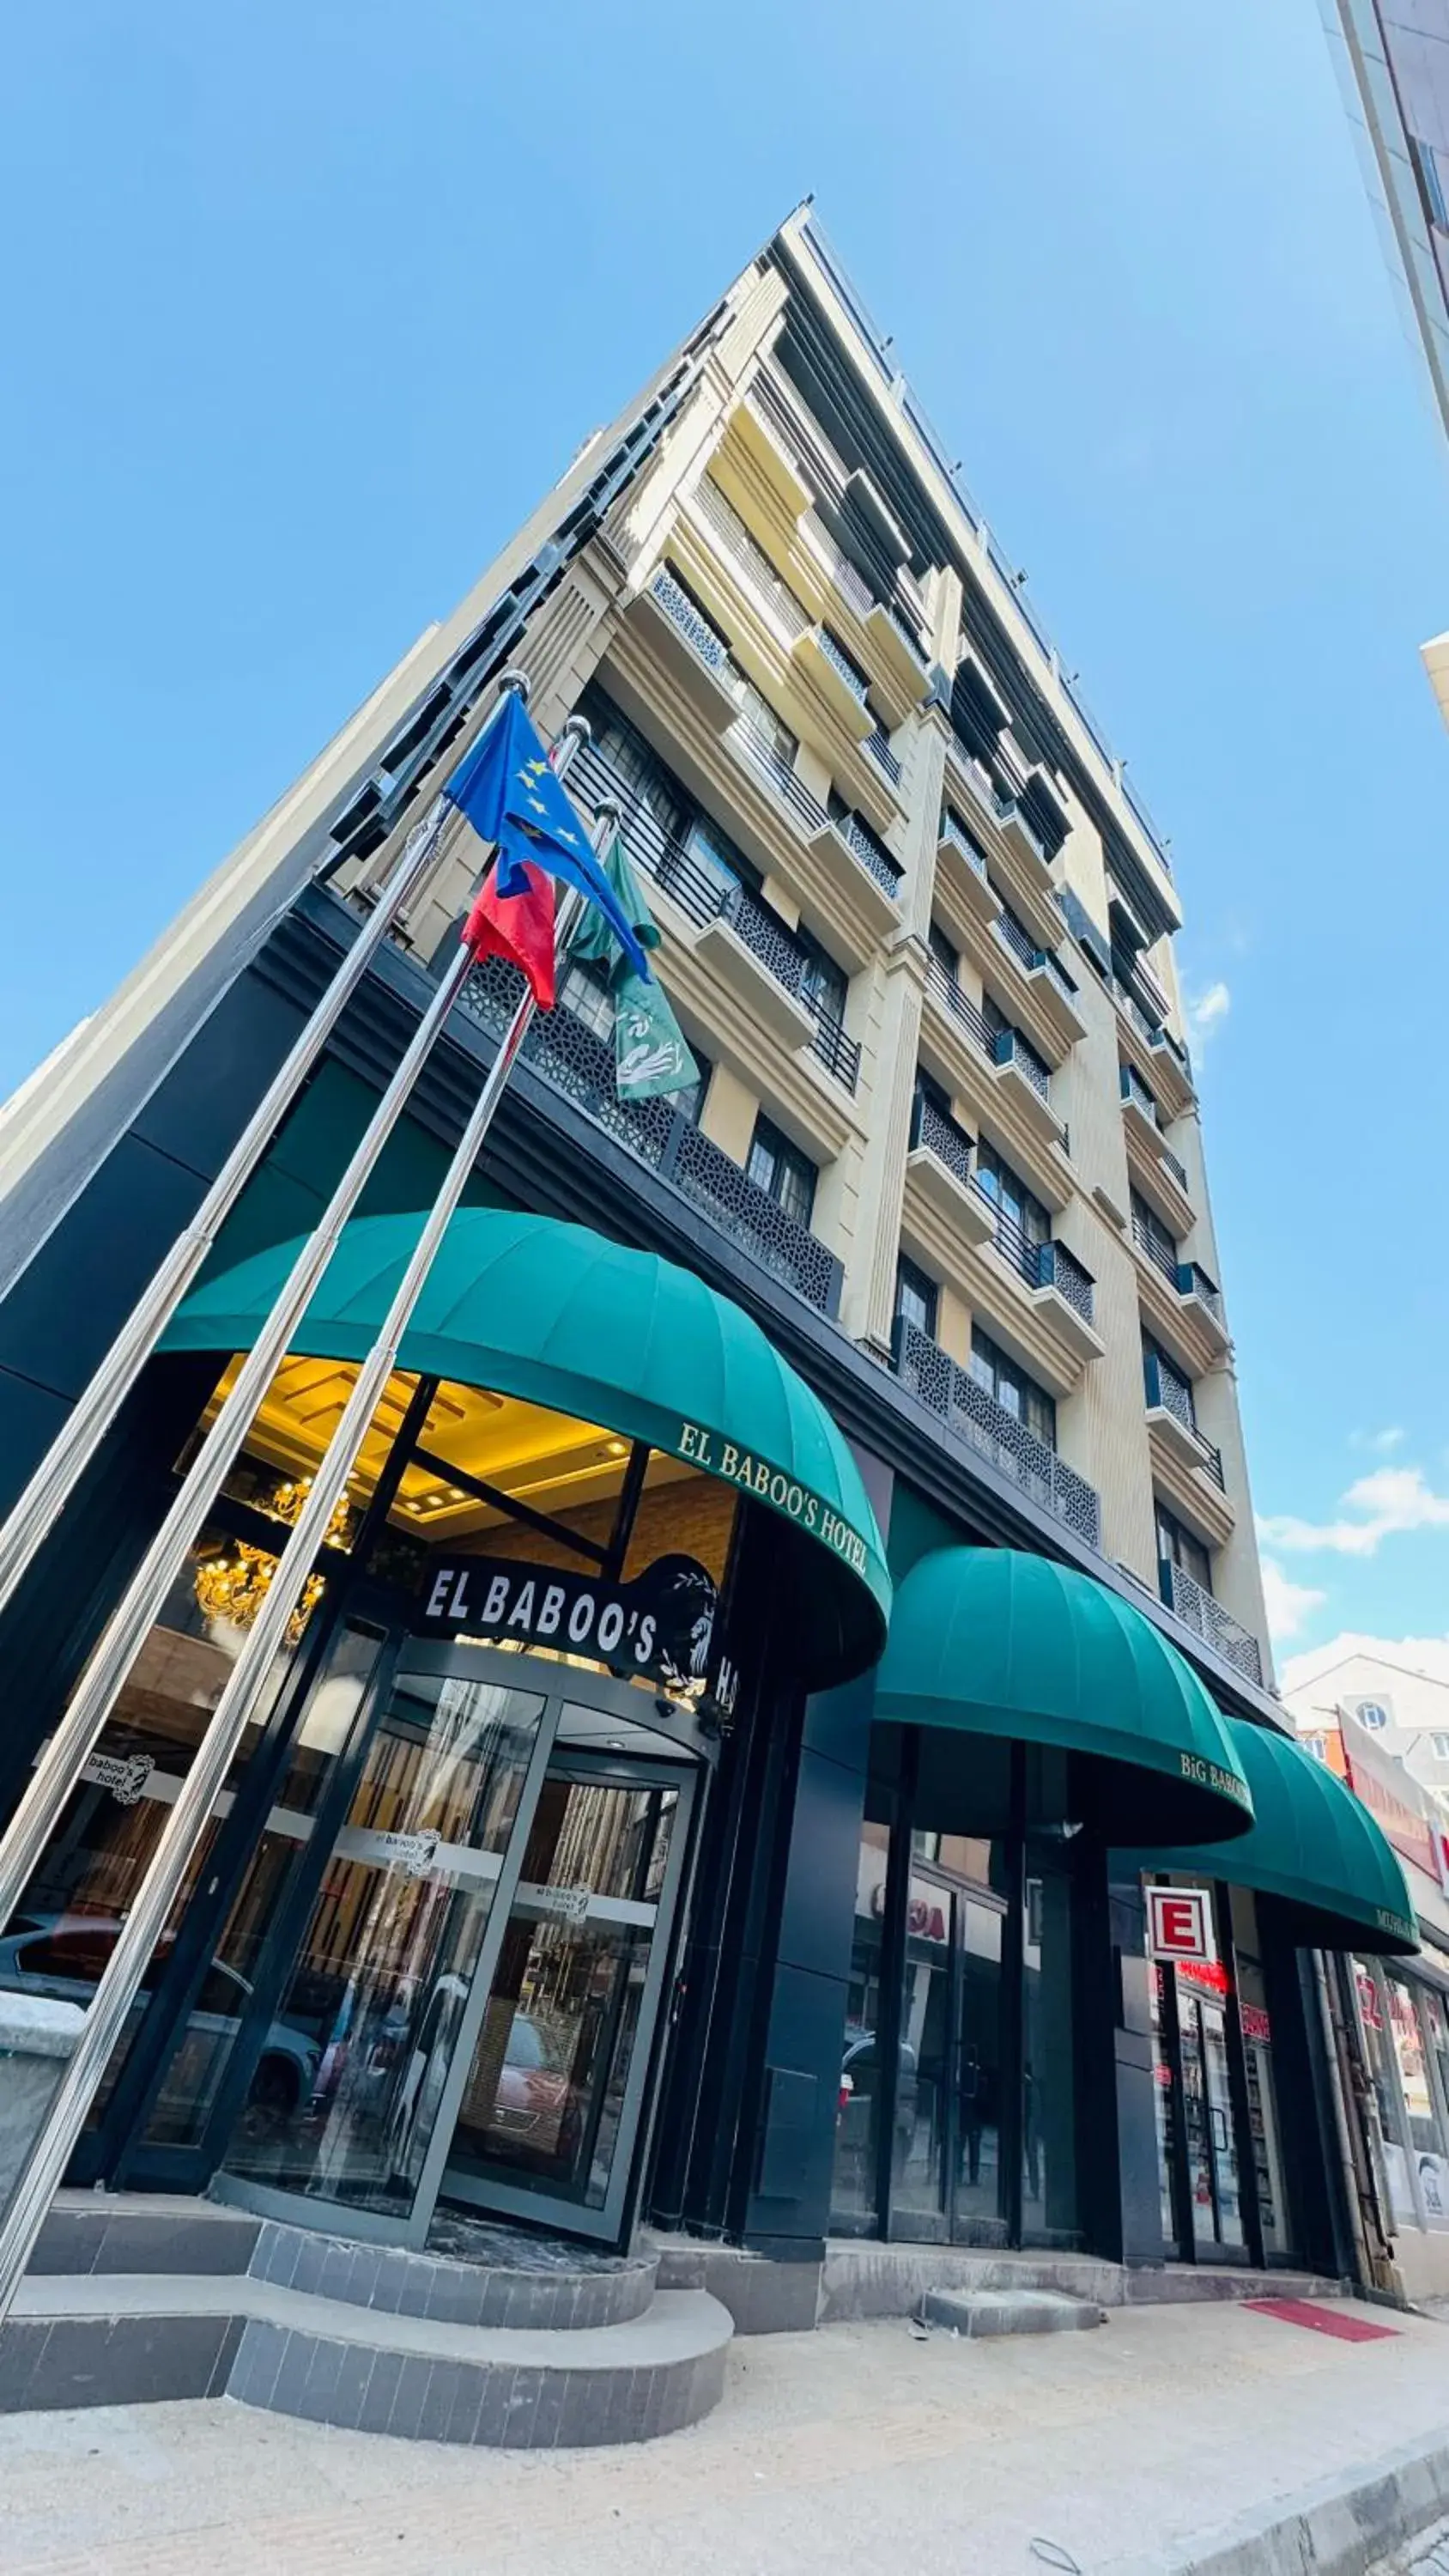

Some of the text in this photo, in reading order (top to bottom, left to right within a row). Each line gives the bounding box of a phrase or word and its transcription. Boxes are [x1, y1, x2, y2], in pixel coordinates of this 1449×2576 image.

[677, 1423, 867, 1573] EL BABOO'S HOTEL
[426, 1570, 657, 1663] EL BABOO'S
[1162, 1903, 1196, 1947] E
